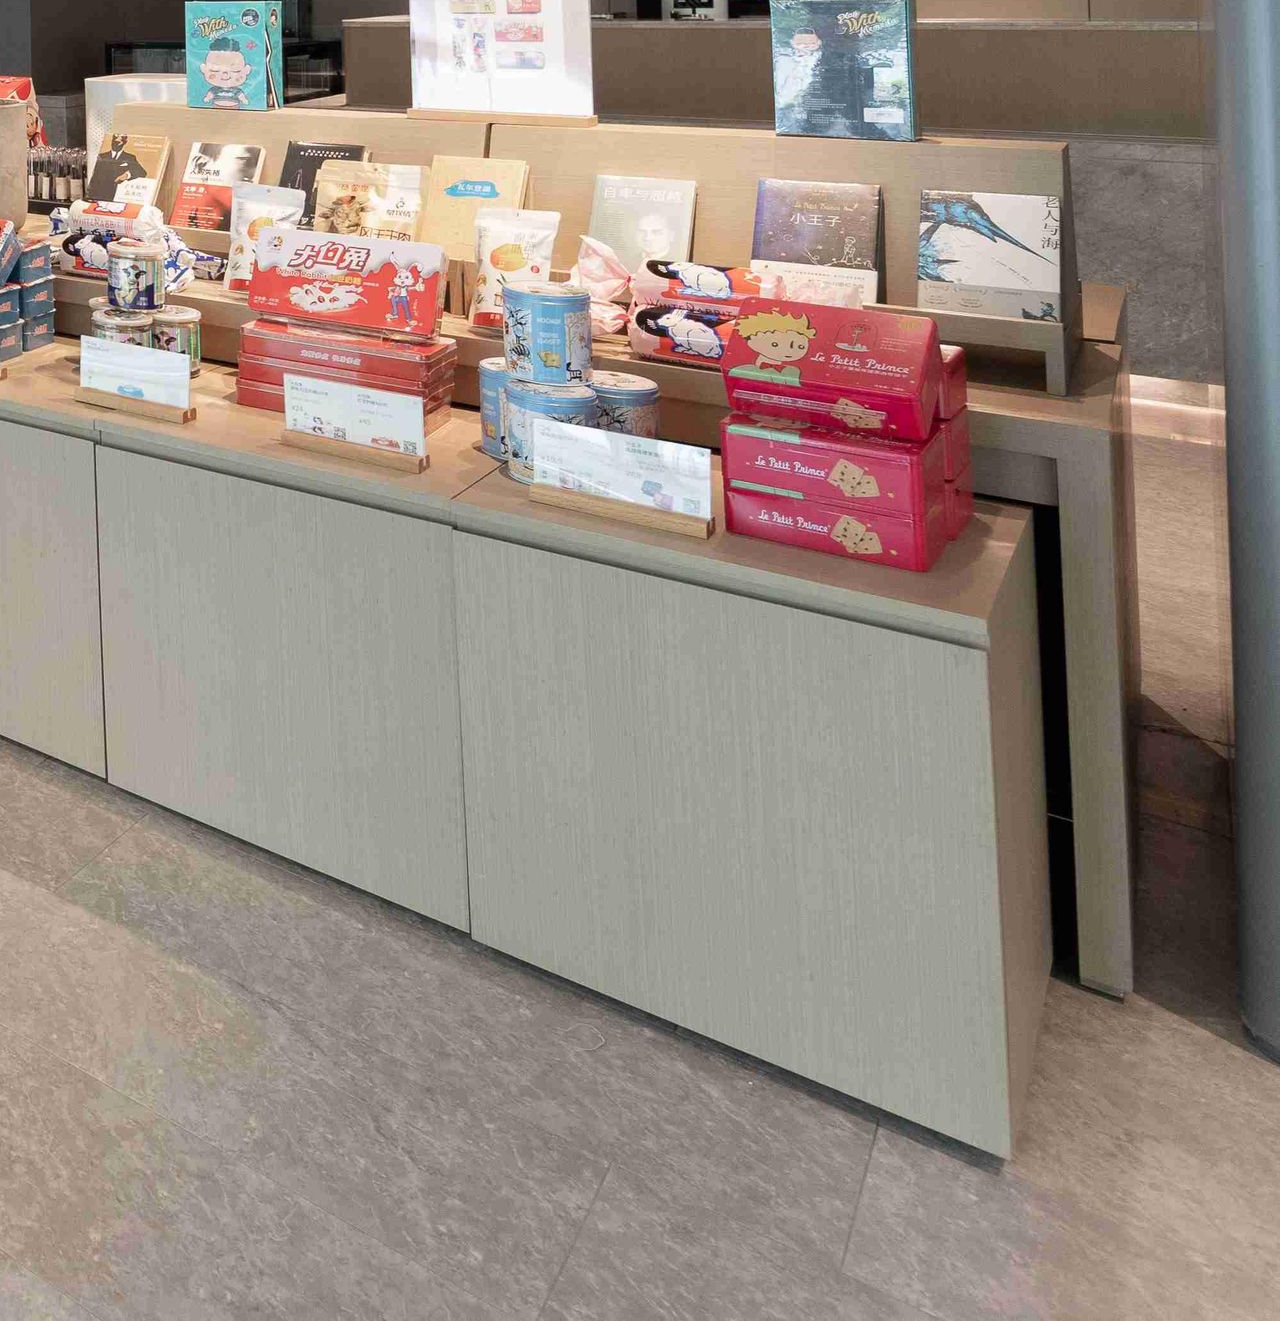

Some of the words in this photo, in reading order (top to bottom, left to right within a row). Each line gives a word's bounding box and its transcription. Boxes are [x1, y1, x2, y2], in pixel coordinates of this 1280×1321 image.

[199, 16, 228, 37] With
[846, 11, 882, 32] With
[790, 212, 842, 227] 小王子
[1042, 195, 1061, 250] 老人与海
[287, 241, 371, 272] 大白兔
[276, 267, 300, 278] White
[301, 270, 328, 280] Rabbit
[810, 352, 826, 363] Le
[830, 354, 860, 367] Petit
[865, 358, 910, 375] Prince
[755, 455, 766, 466] Le
[769, 457, 791, 471] Petit
[794, 462, 826, 477] Prince
[758, 510, 769, 521] Le
[771, 511, 794, 526] Petit
[797, 516, 829, 533] Prince
